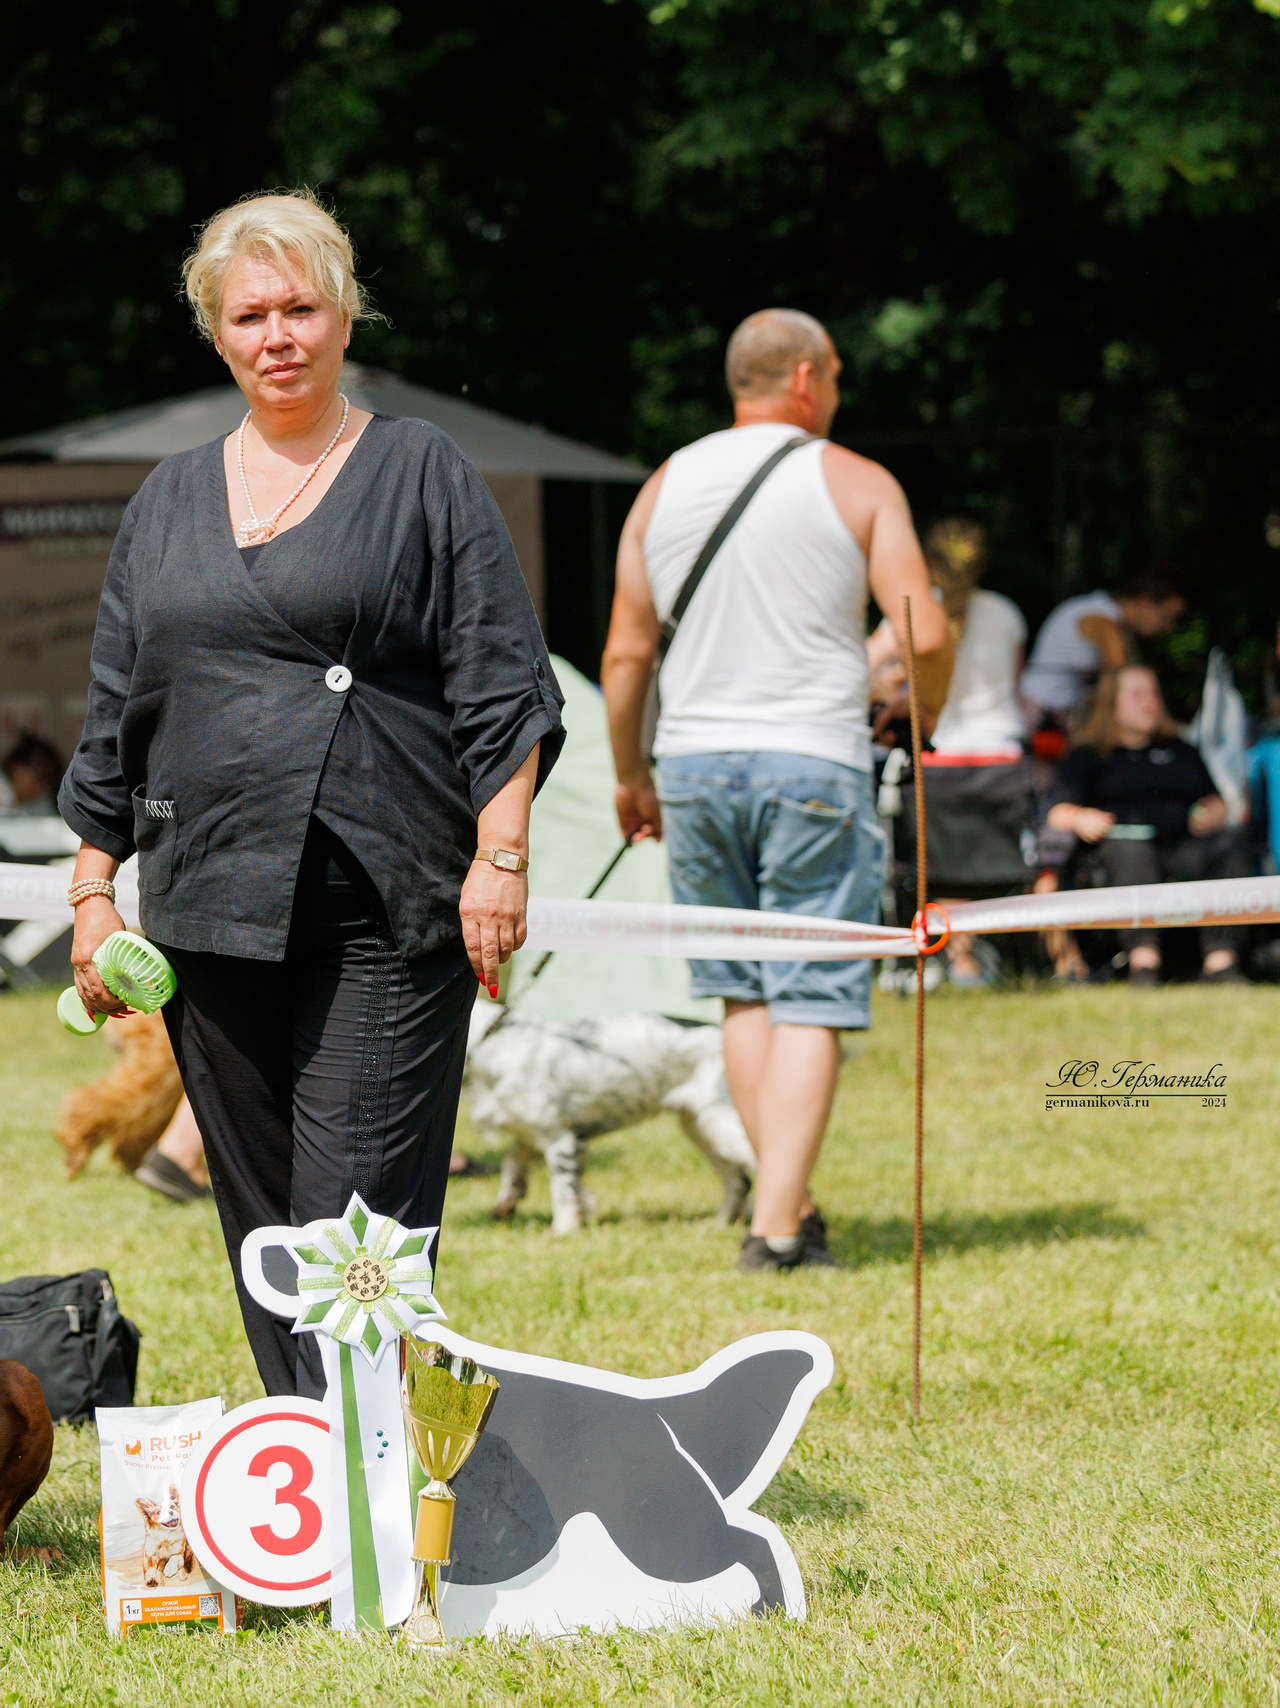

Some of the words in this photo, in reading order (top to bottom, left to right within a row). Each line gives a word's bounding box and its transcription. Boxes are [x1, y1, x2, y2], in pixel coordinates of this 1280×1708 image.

[149, 1430, 202, 1451] RUSH
[123, 1459, 144, 1469] Super
[151, 1454, 171, 1462] Pet
[247, 1444, 322, 1556] 3
